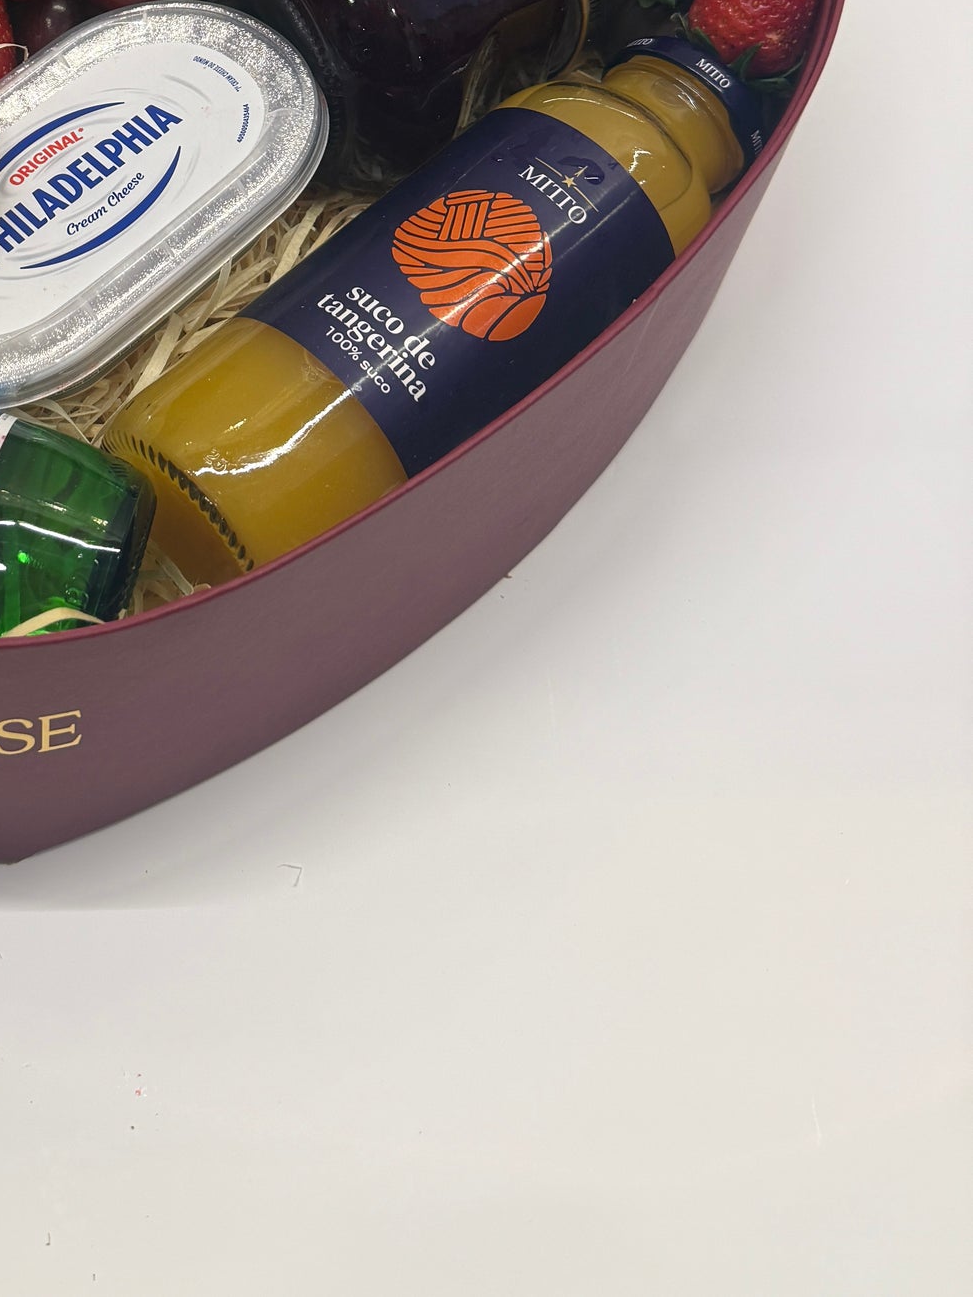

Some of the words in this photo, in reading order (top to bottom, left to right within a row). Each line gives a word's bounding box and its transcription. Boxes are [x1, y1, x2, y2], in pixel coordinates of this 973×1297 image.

[695, 58, 731, 89] MITTO
[8, 130, 83, 186] ORIGINAL
[66, 204, 108, 236] Cream
[107, 171, 145, 207] Cheese
[518, 164, 588, 225] MITTO
[316, 292, 427, 402] tangerina
[326, 326, 362, 362] 100%
[361, 360, 391, 394] suco
[345, 285, 405, 335] suco
[404, 332, 436, 371] de
